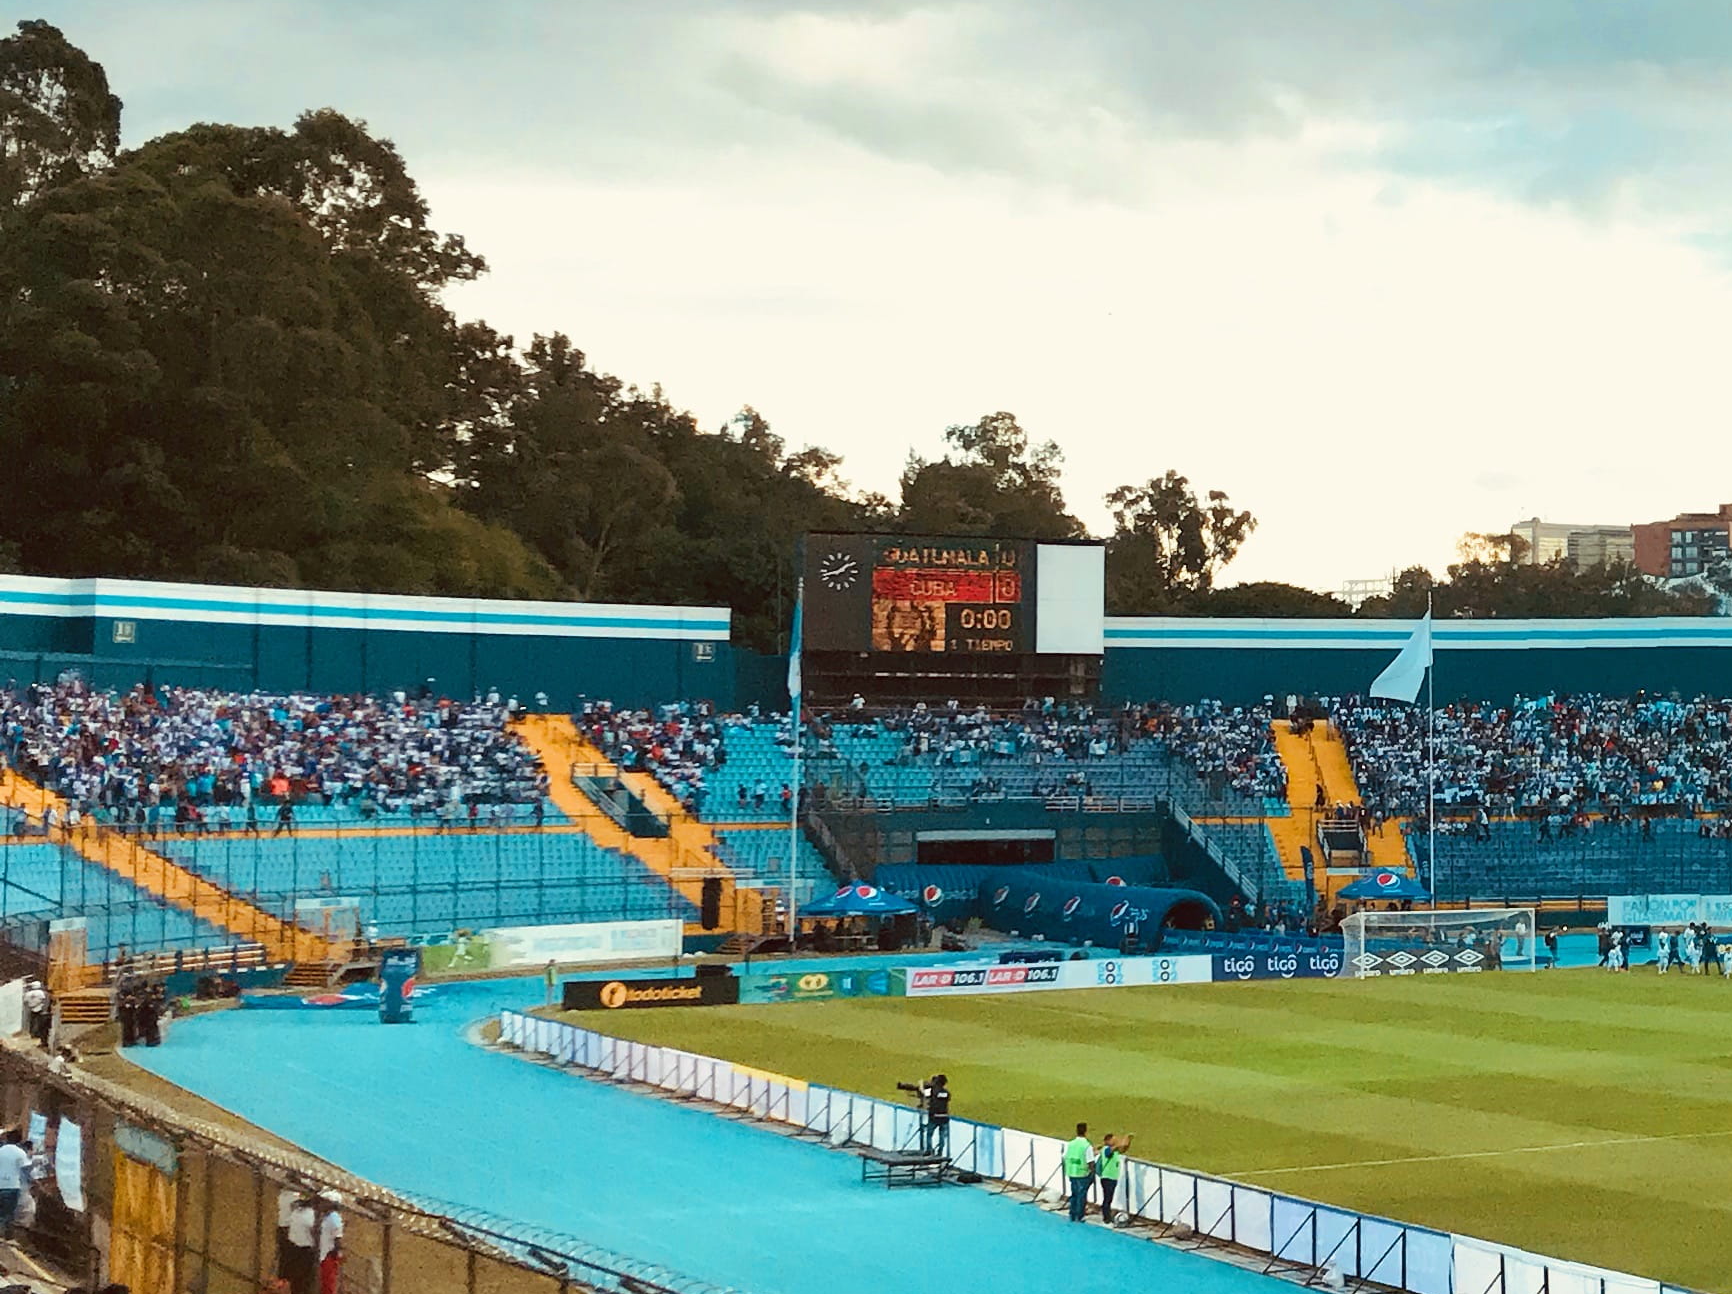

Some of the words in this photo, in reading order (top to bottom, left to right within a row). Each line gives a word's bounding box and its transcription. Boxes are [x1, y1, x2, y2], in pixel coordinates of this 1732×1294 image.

[910, 581, 957, 597] CUBA
[960, 609, 1012, 629] 0:00
[965, 639, 1013, 651] TIEMPO
[1224, 955, 1255, 979] tigo
[1267, 954, 1297, 978] tigo
[1309, 954, 1339, 977] tigo
[954, 973, 983, 985] 106.1
[1028, 968, 1057, 980] 106.1
